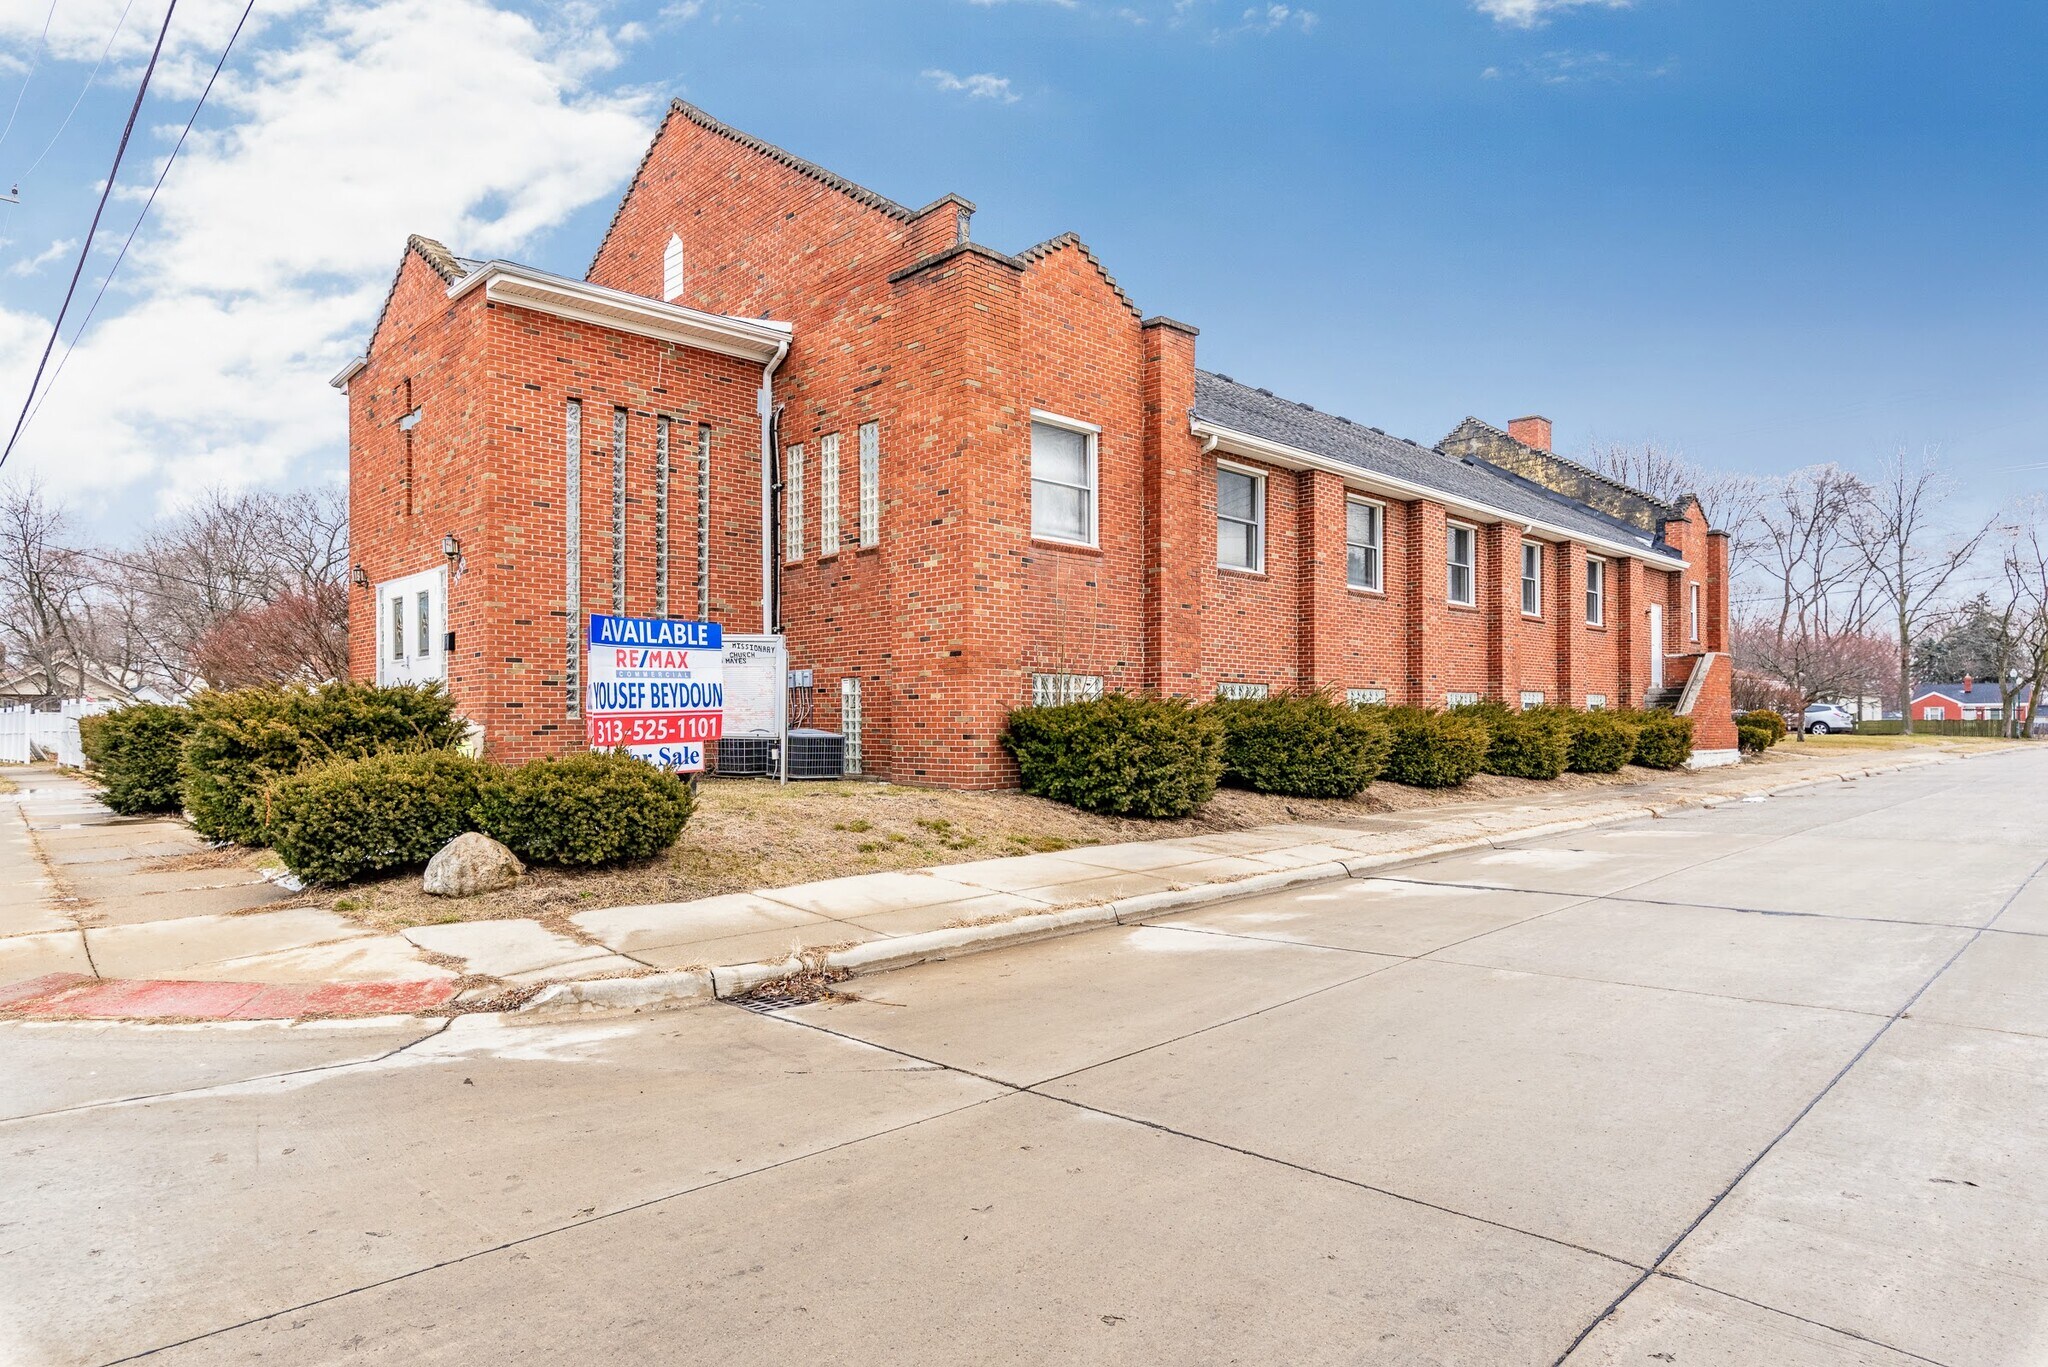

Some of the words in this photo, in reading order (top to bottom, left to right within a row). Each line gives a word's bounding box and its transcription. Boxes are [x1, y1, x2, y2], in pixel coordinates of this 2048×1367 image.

[601, 618, 708, 646] AVAILABLE
[729, 651, 756, 659] CHURCH
[732, 643, 775, 653] MISSIONARY
[616, 649, 688, 668] RE/MAX
[593, 682, 645, 709] YOUSEF
[650, 683, 722, 708] BEYDOUN
[597, 717, 716, 743] 313-525-1101
[659, 746, 699, 766] Sale
